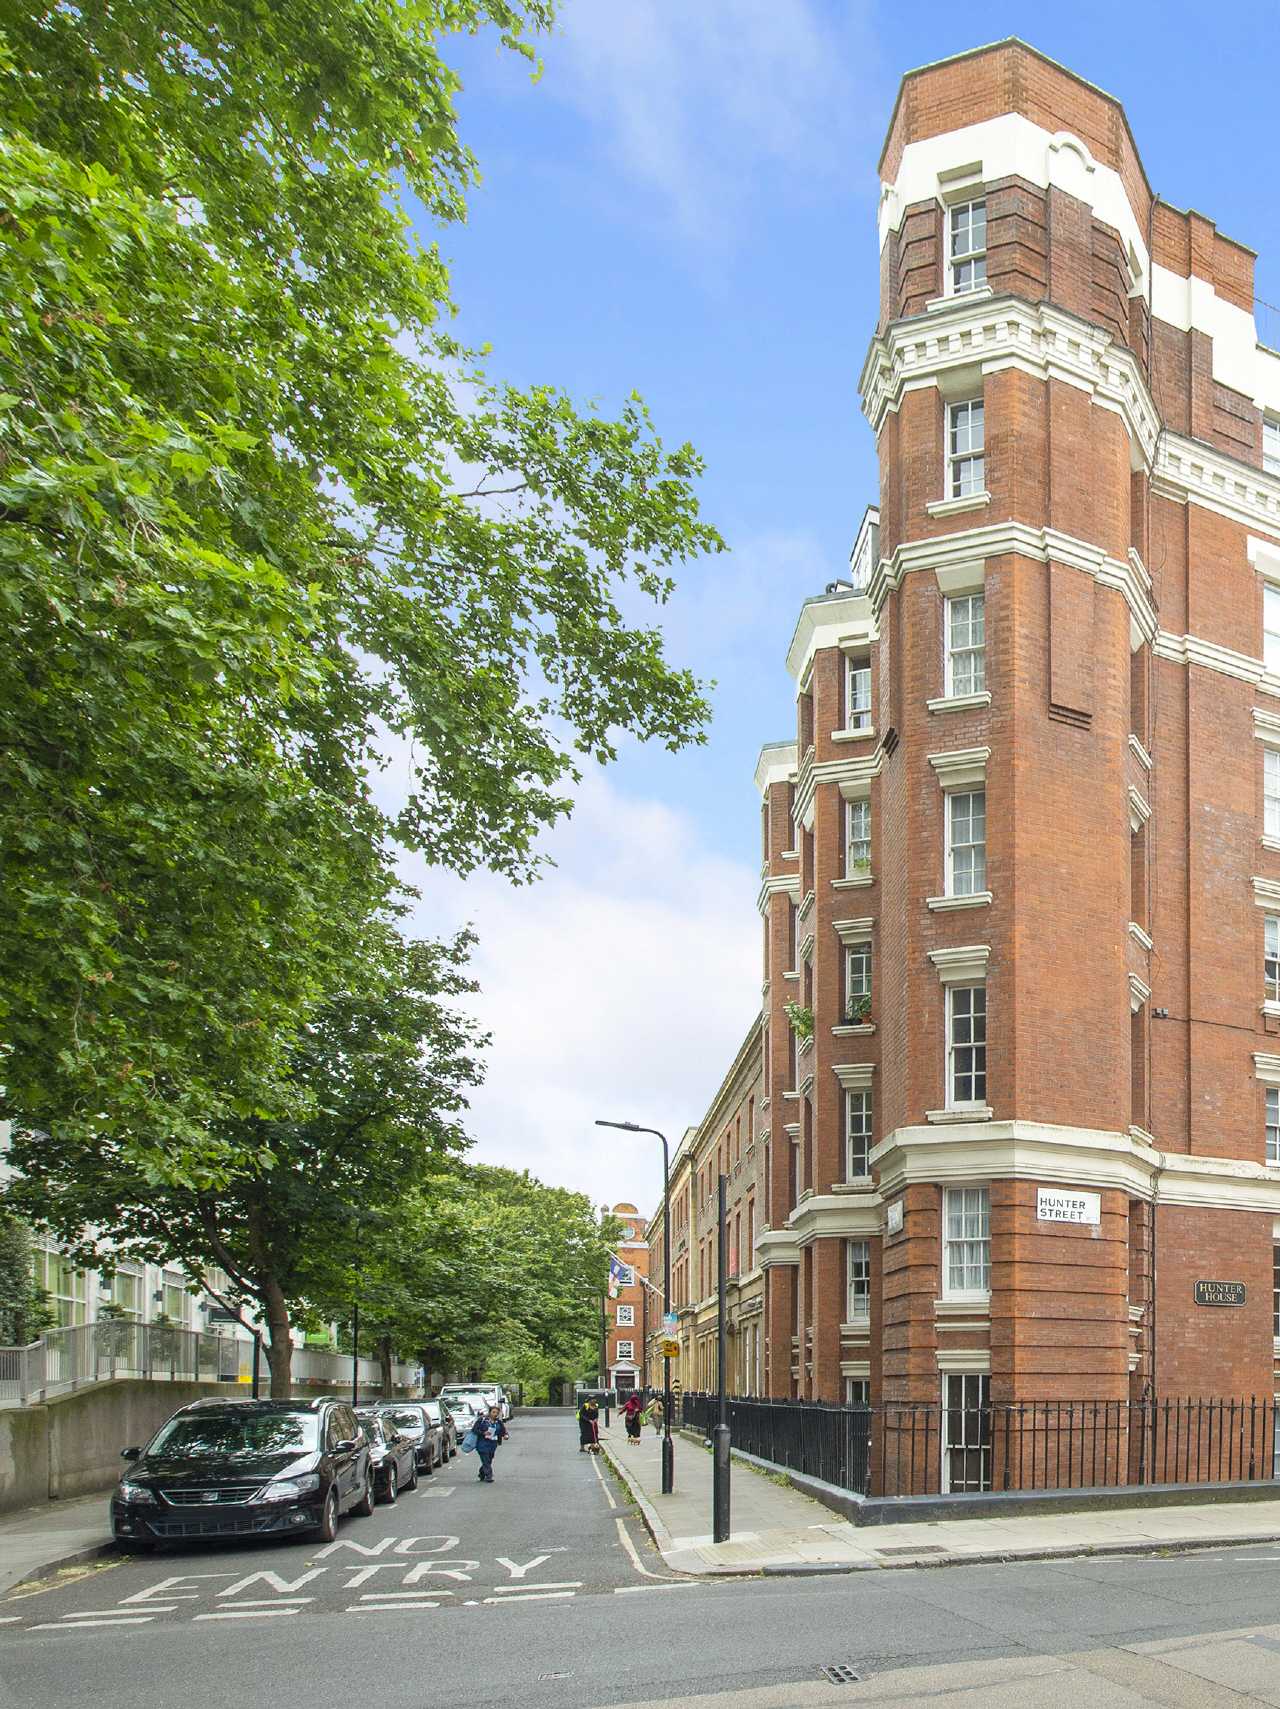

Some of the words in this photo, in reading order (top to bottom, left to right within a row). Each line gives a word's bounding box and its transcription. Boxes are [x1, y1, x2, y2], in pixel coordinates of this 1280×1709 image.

[1040, 1197, 1086, 1209] HUNTER
[1040, 1208, 1083, 1220] STREET
[1200, 1283, 1242, 1294] HUNTER
[1205, 1292, 1238, 1302] HOUSE
[312, 1535, 460, 1559] NO
[119, 1555, 552, 1604] ENTRY
